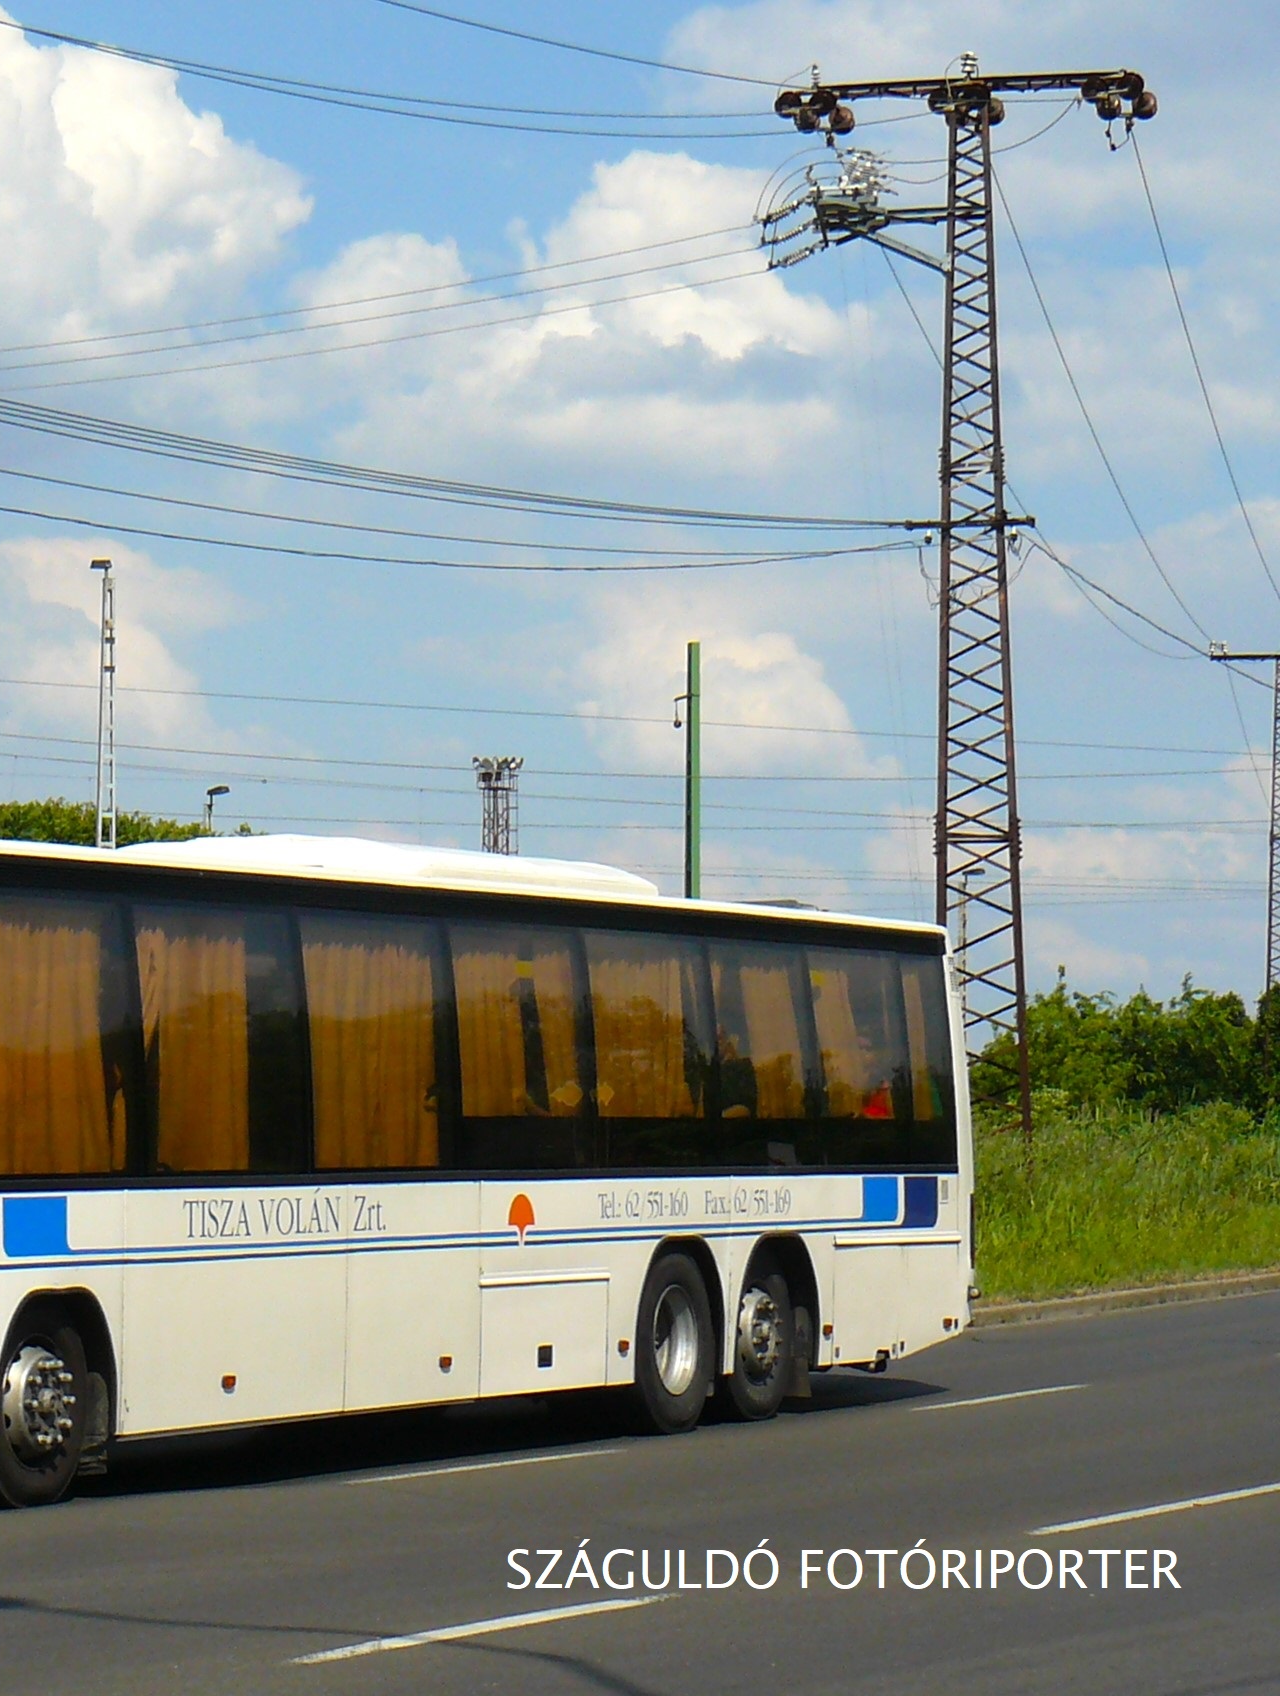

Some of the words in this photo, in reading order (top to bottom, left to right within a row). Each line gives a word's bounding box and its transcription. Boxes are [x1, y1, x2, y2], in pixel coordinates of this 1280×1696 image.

[183, 1199, 251, 1239] TISZA
[258, 1187, 341, 1236] VOLÁN
[353, 1195, 386, 1232] Zrt.
